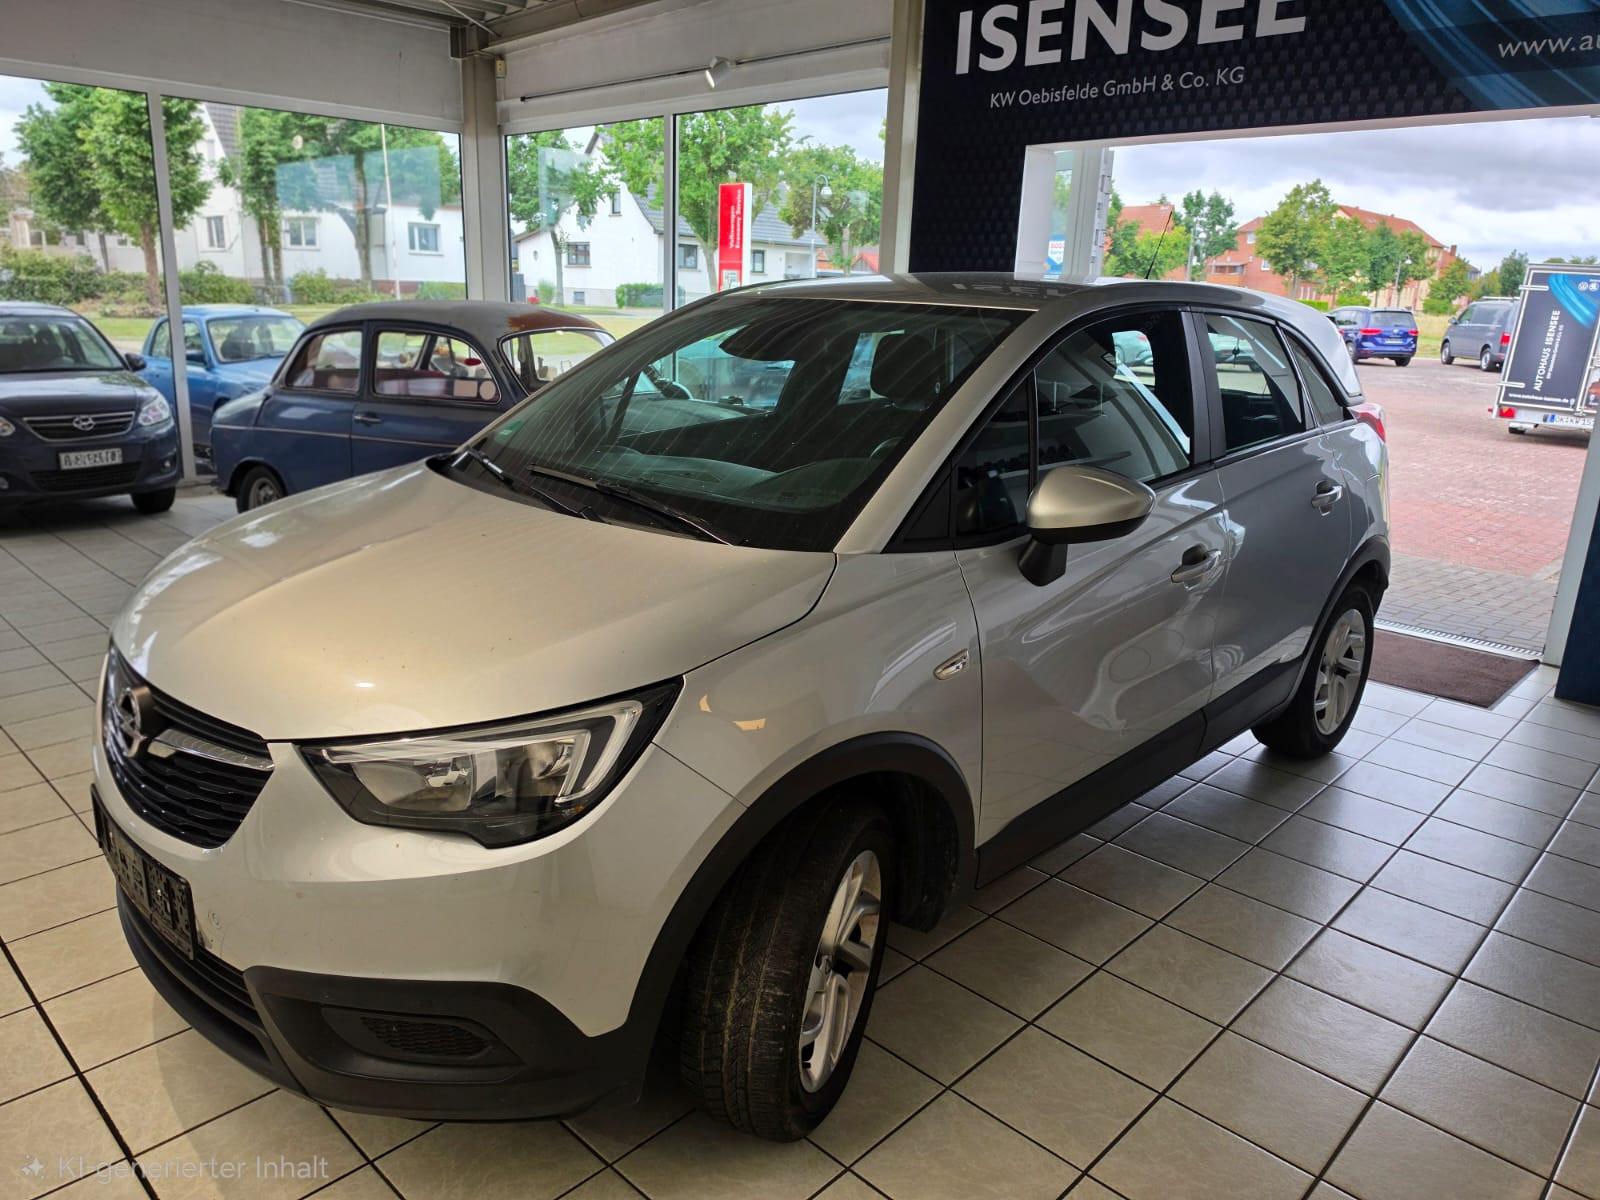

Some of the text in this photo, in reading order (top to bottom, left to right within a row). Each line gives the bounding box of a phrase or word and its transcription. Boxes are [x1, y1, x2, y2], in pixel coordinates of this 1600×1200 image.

[955, 0, 1306, 75] ISENSEE
[1498, 34, 1600, 58] www.a
[990, 66, 1245, 109] KW Oebisfelde GmbH & Co. KG
[1533, 347, 1551, 391] AUTOHAUS
[1544, 310, 1560, 345] ISENSEE
